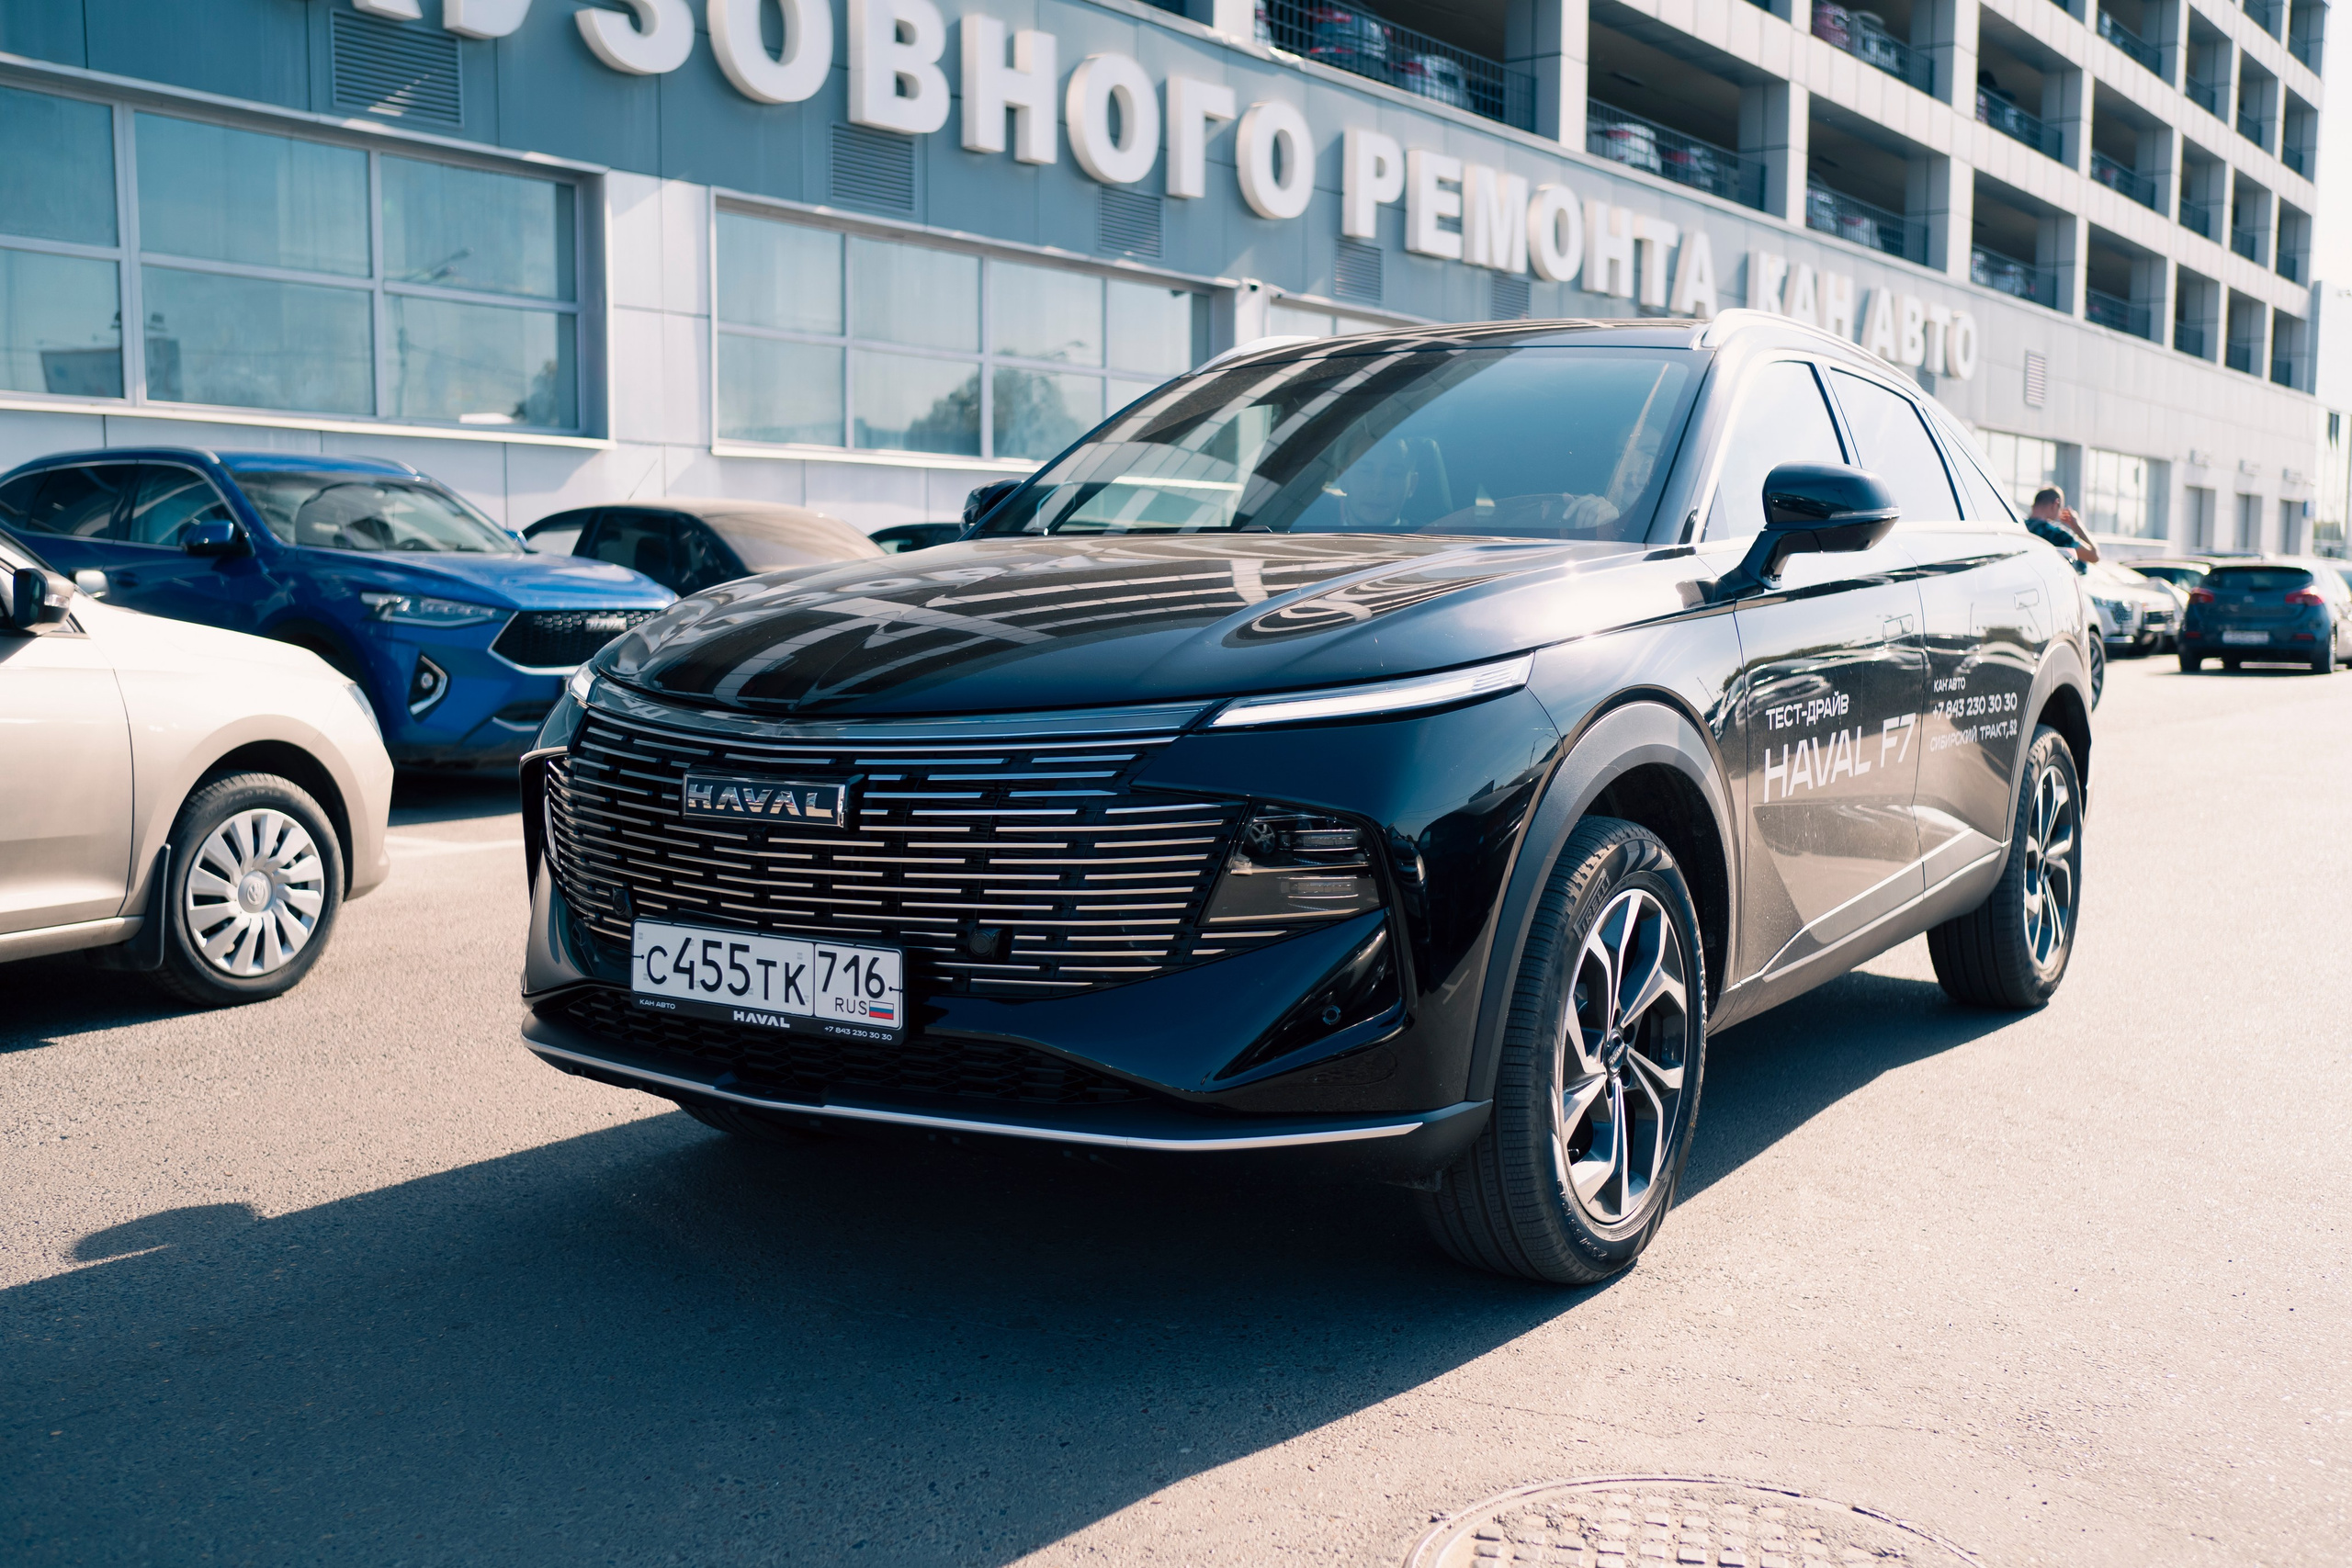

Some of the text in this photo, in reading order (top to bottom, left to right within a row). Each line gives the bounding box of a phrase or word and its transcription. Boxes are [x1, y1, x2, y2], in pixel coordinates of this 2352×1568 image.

[353, 0, 1977, 381] ОВНОГО РЕМОНТА КАН АВТО
[1933, 676, 1966, 693] КАН АВТО
[1765, 691, 1849, 730] ТЕСТ-ДРАЙВ
[1932, 692, 2018, 720] +7 843 230 30 30
[1929, 725, 1978, 752] СИБИРСКИЙ
[1763, 712, 1917, 804] HAVAL F7
[688, 784, 833, 818] HAVAL
[818, 950, 887, 999] 716
[639, 998, 676, 1010] КАН АВТО
[834, 997, 868, 1016] RUS
[733, 1010, 790, 1029] HAVAL
[835, 1027, 851, 1035] 843
[852, 1029, 868, 1038] 230
[869, 1031, 880, 1040] 30
[881, 1032, 893, 1041] 30
